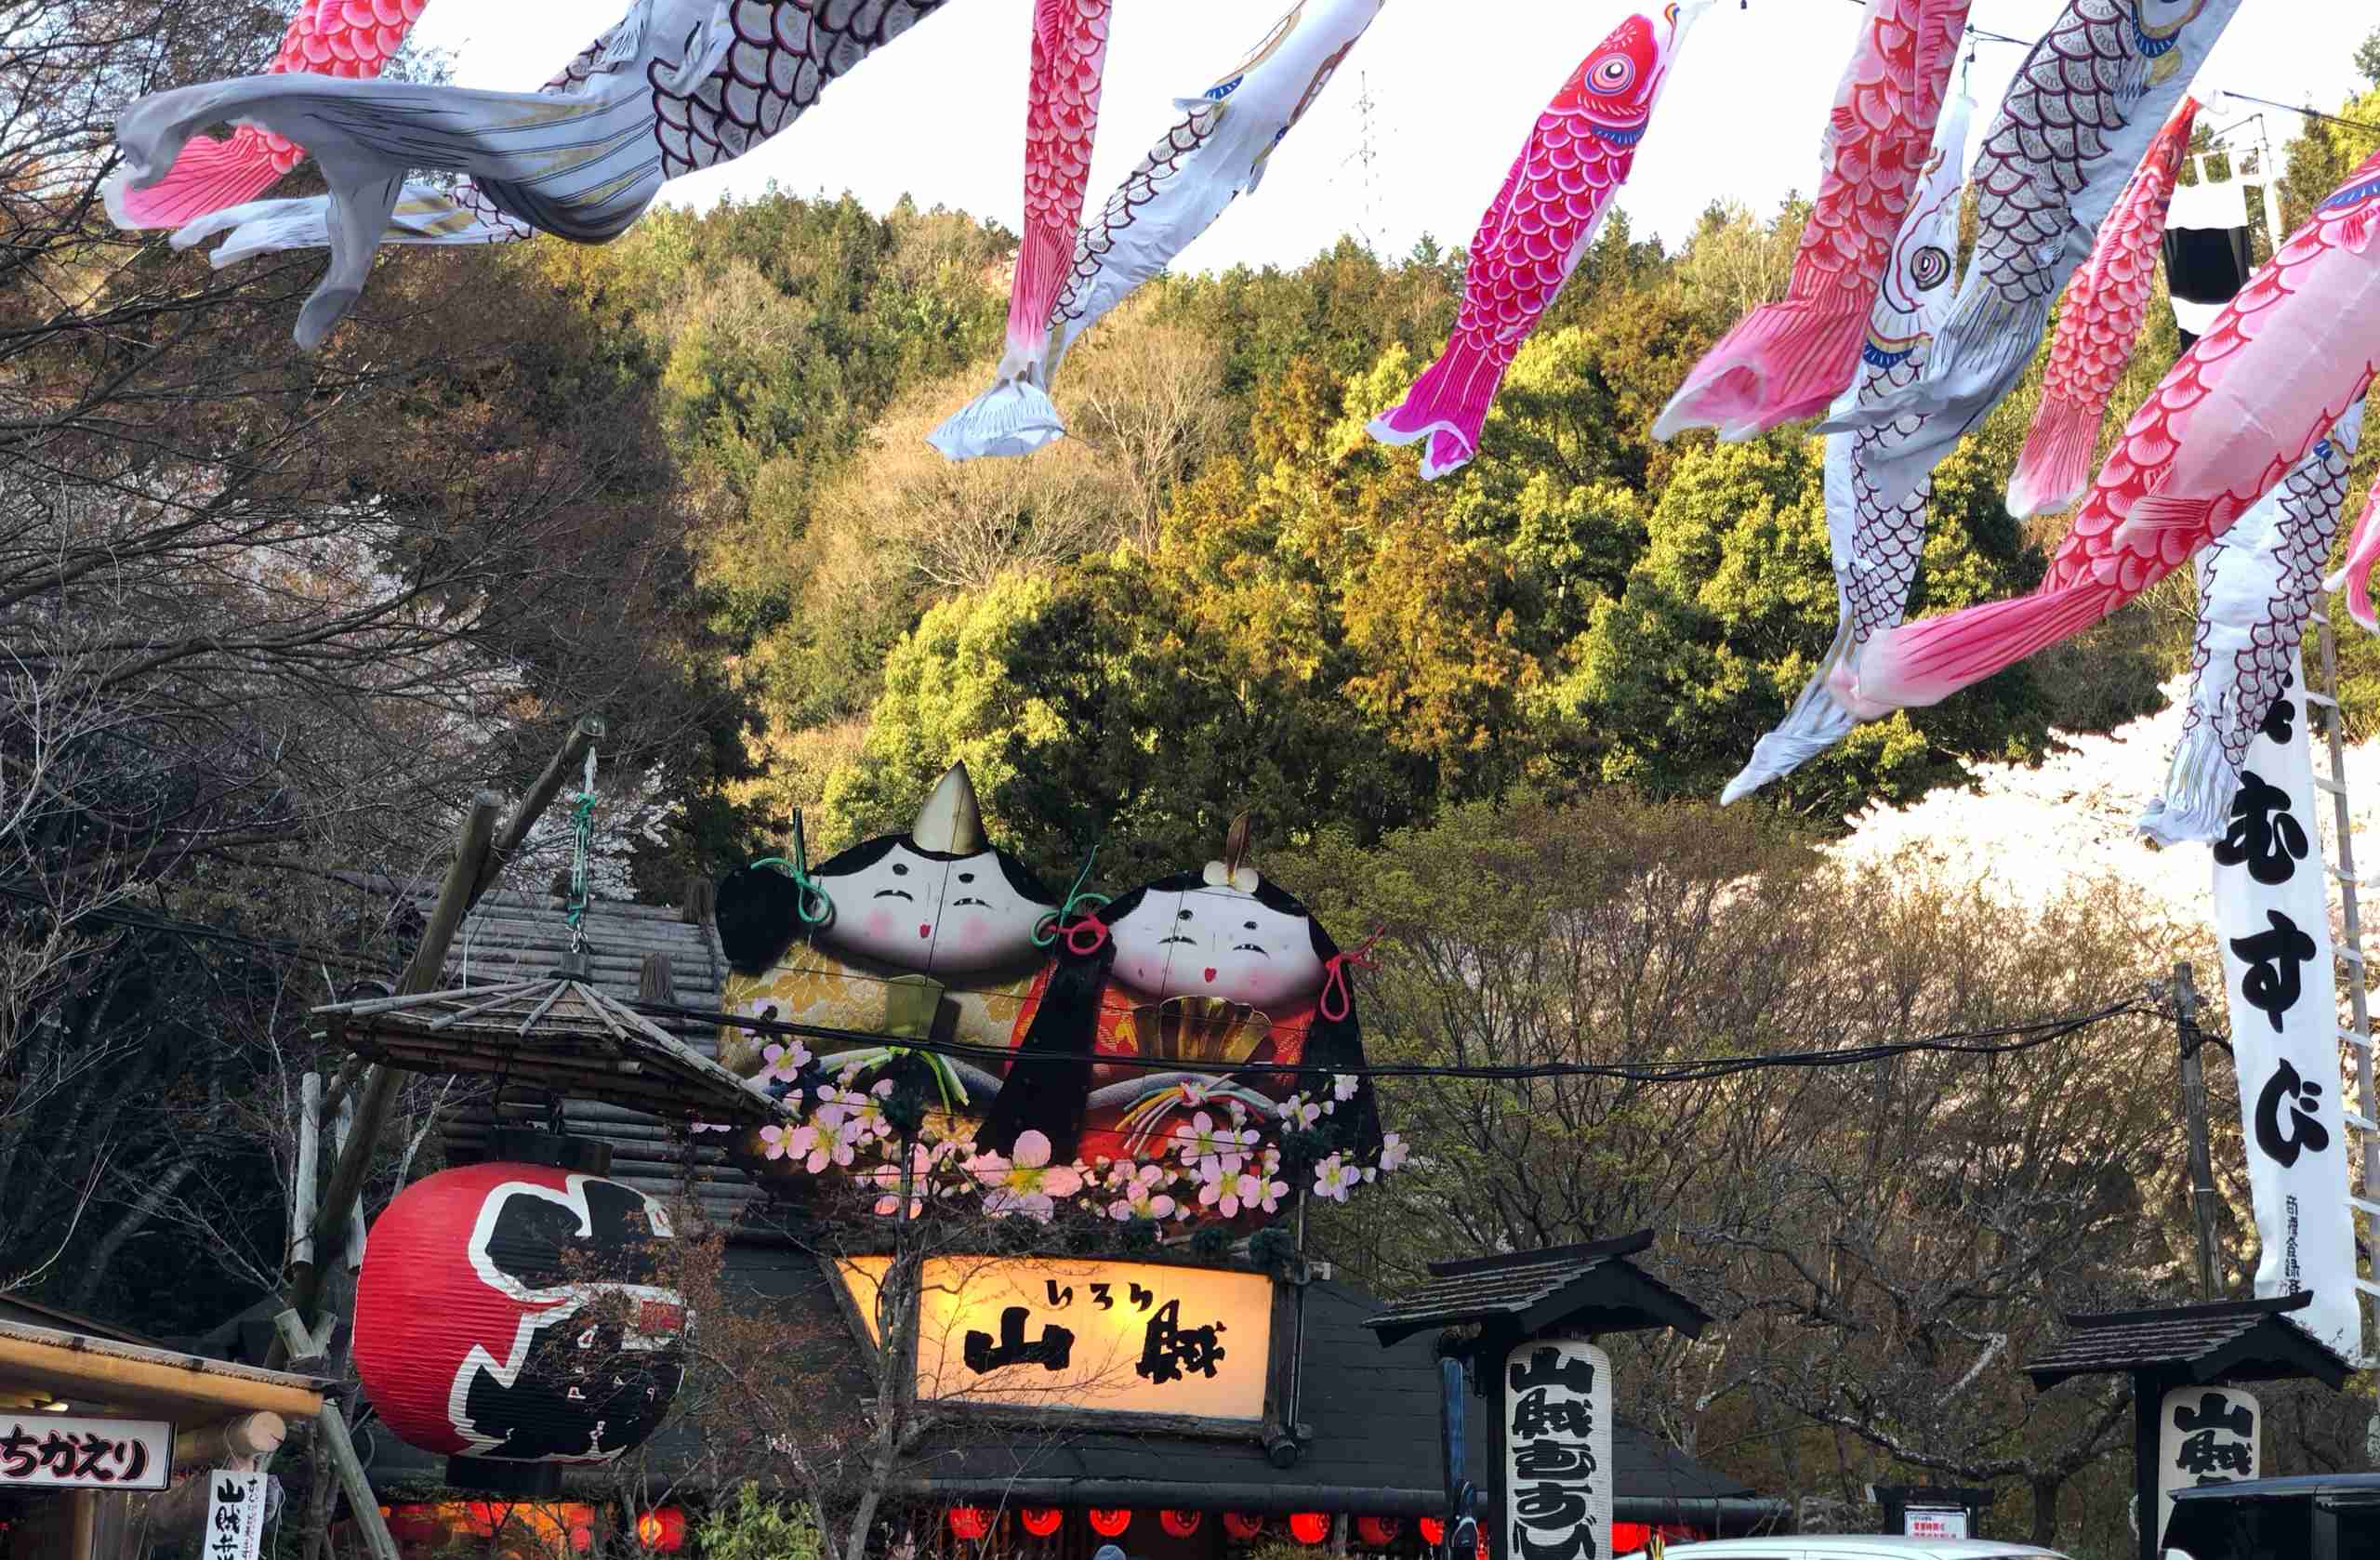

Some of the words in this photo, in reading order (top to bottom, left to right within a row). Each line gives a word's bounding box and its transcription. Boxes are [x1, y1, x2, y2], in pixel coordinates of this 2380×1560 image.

[1045, 1279, 1154, 1312] いろり
[964, 1299, 1227, 1384] 山賊
[0, 1424, 147, 1481] ちかえり
[1509, 1346, 1597, 1560] 山賊むすび
[2174, 1393, 2254, 1487] 山賊
[212, 1478, 245, 1560] 山賊弁
